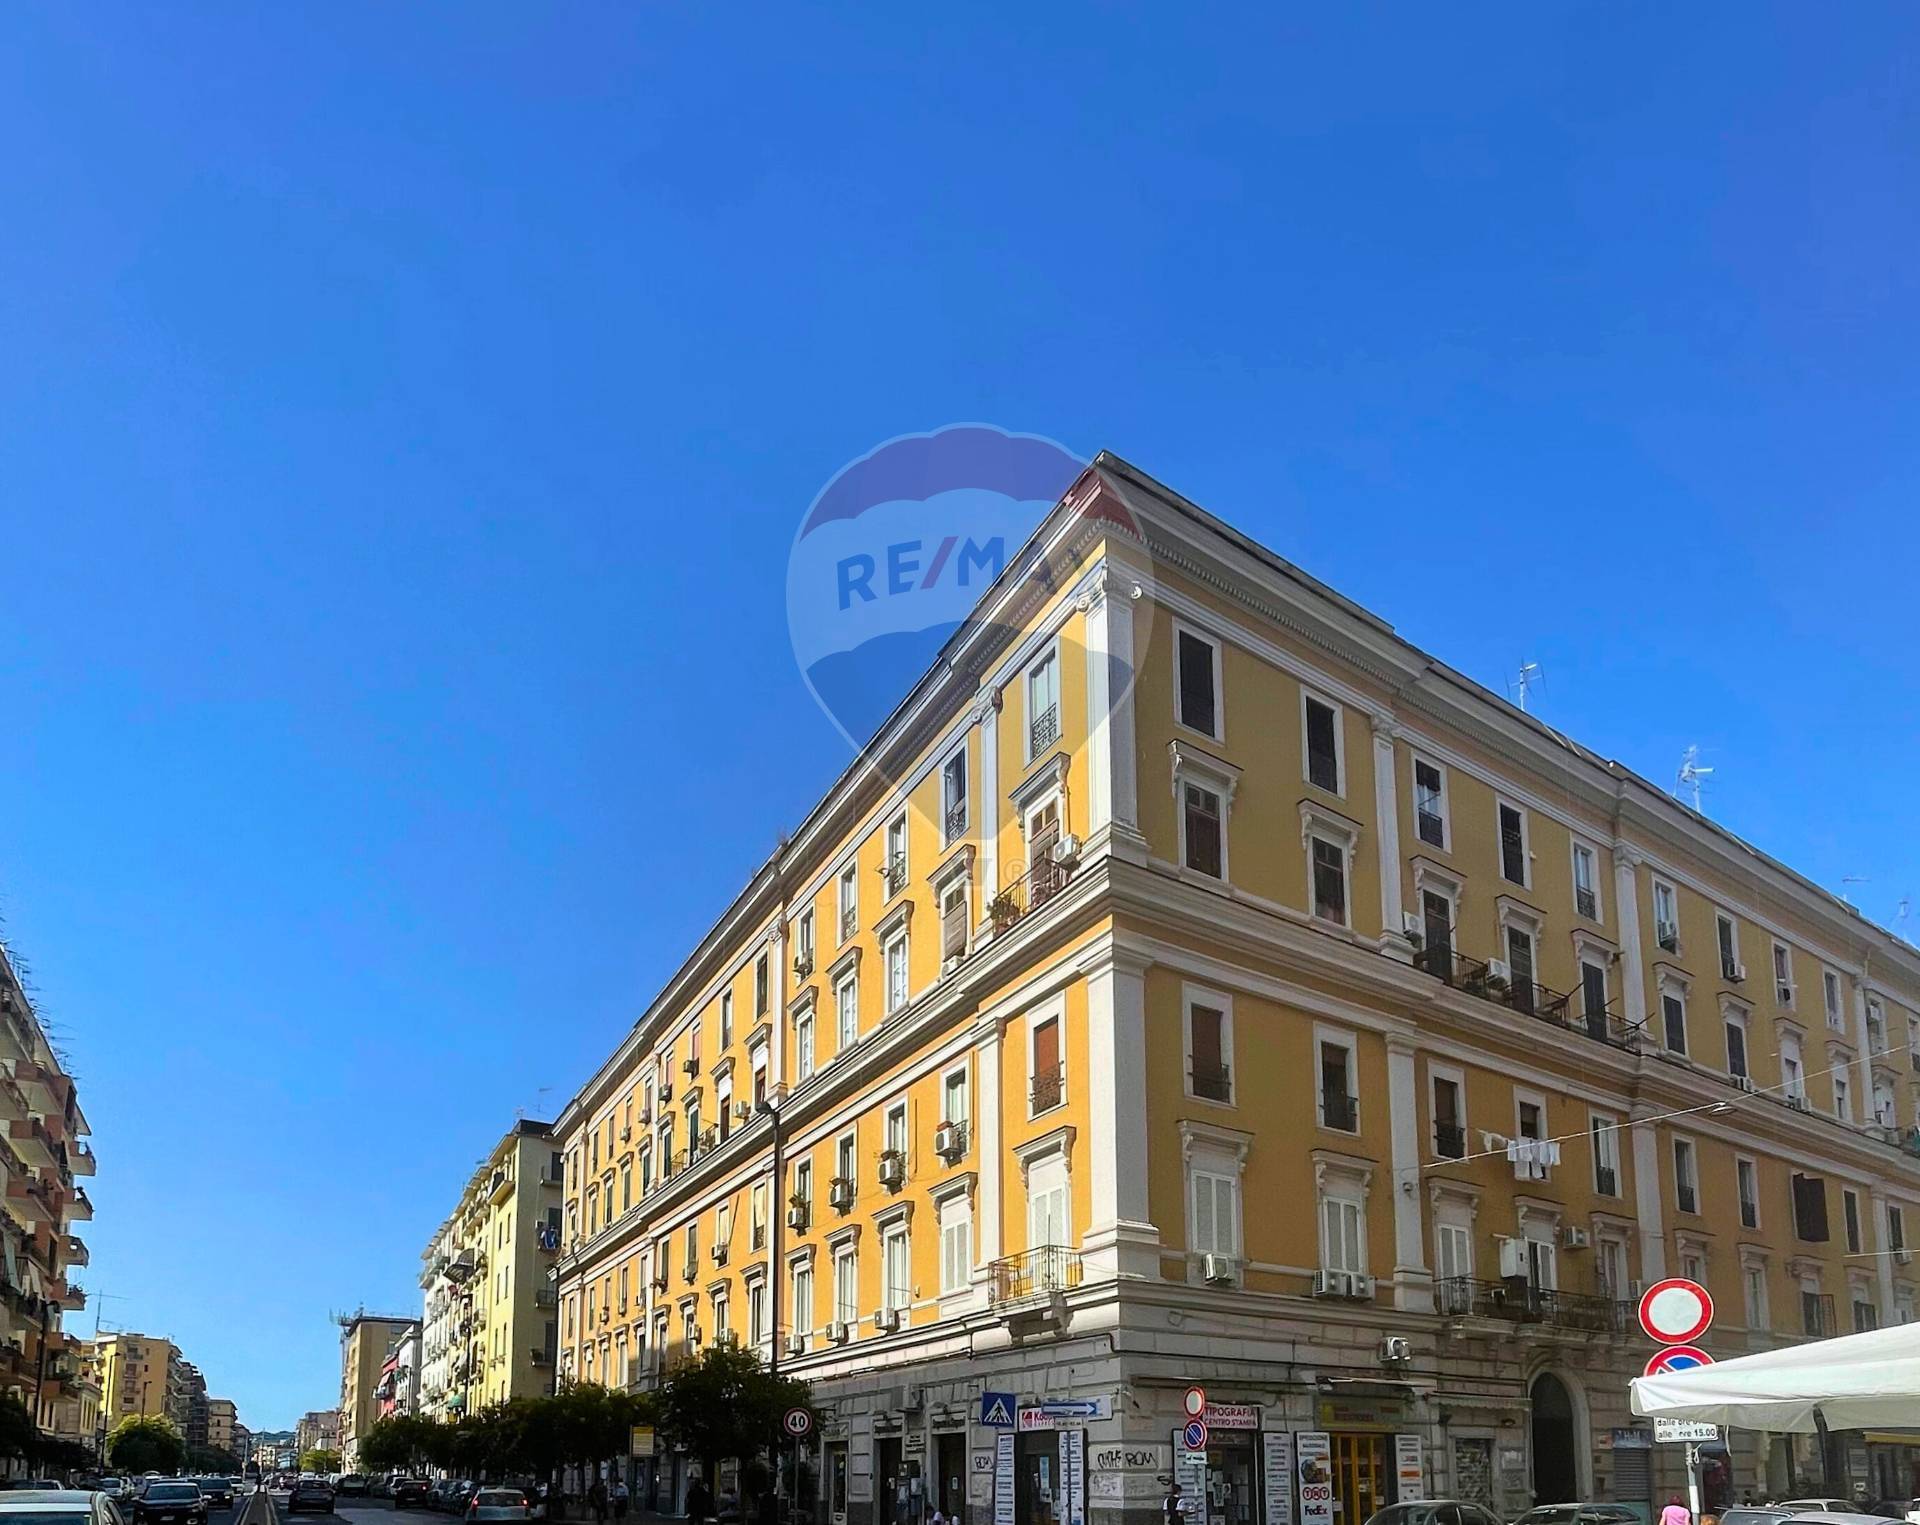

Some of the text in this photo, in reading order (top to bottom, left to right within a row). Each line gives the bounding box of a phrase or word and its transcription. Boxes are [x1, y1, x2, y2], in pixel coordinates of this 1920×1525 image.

[1204, 1406, 1256, 1418] TIPOGRAFIA
[789, 1414, 806, 1429] 40
[1204, 1417, 1230, 1426] CENTRO
[1658, 1430, 1673, 1438] alle
[1693, 1428, 1716, 1437] 15.00
[1304, 1505, 1328, 1516] FedEx
